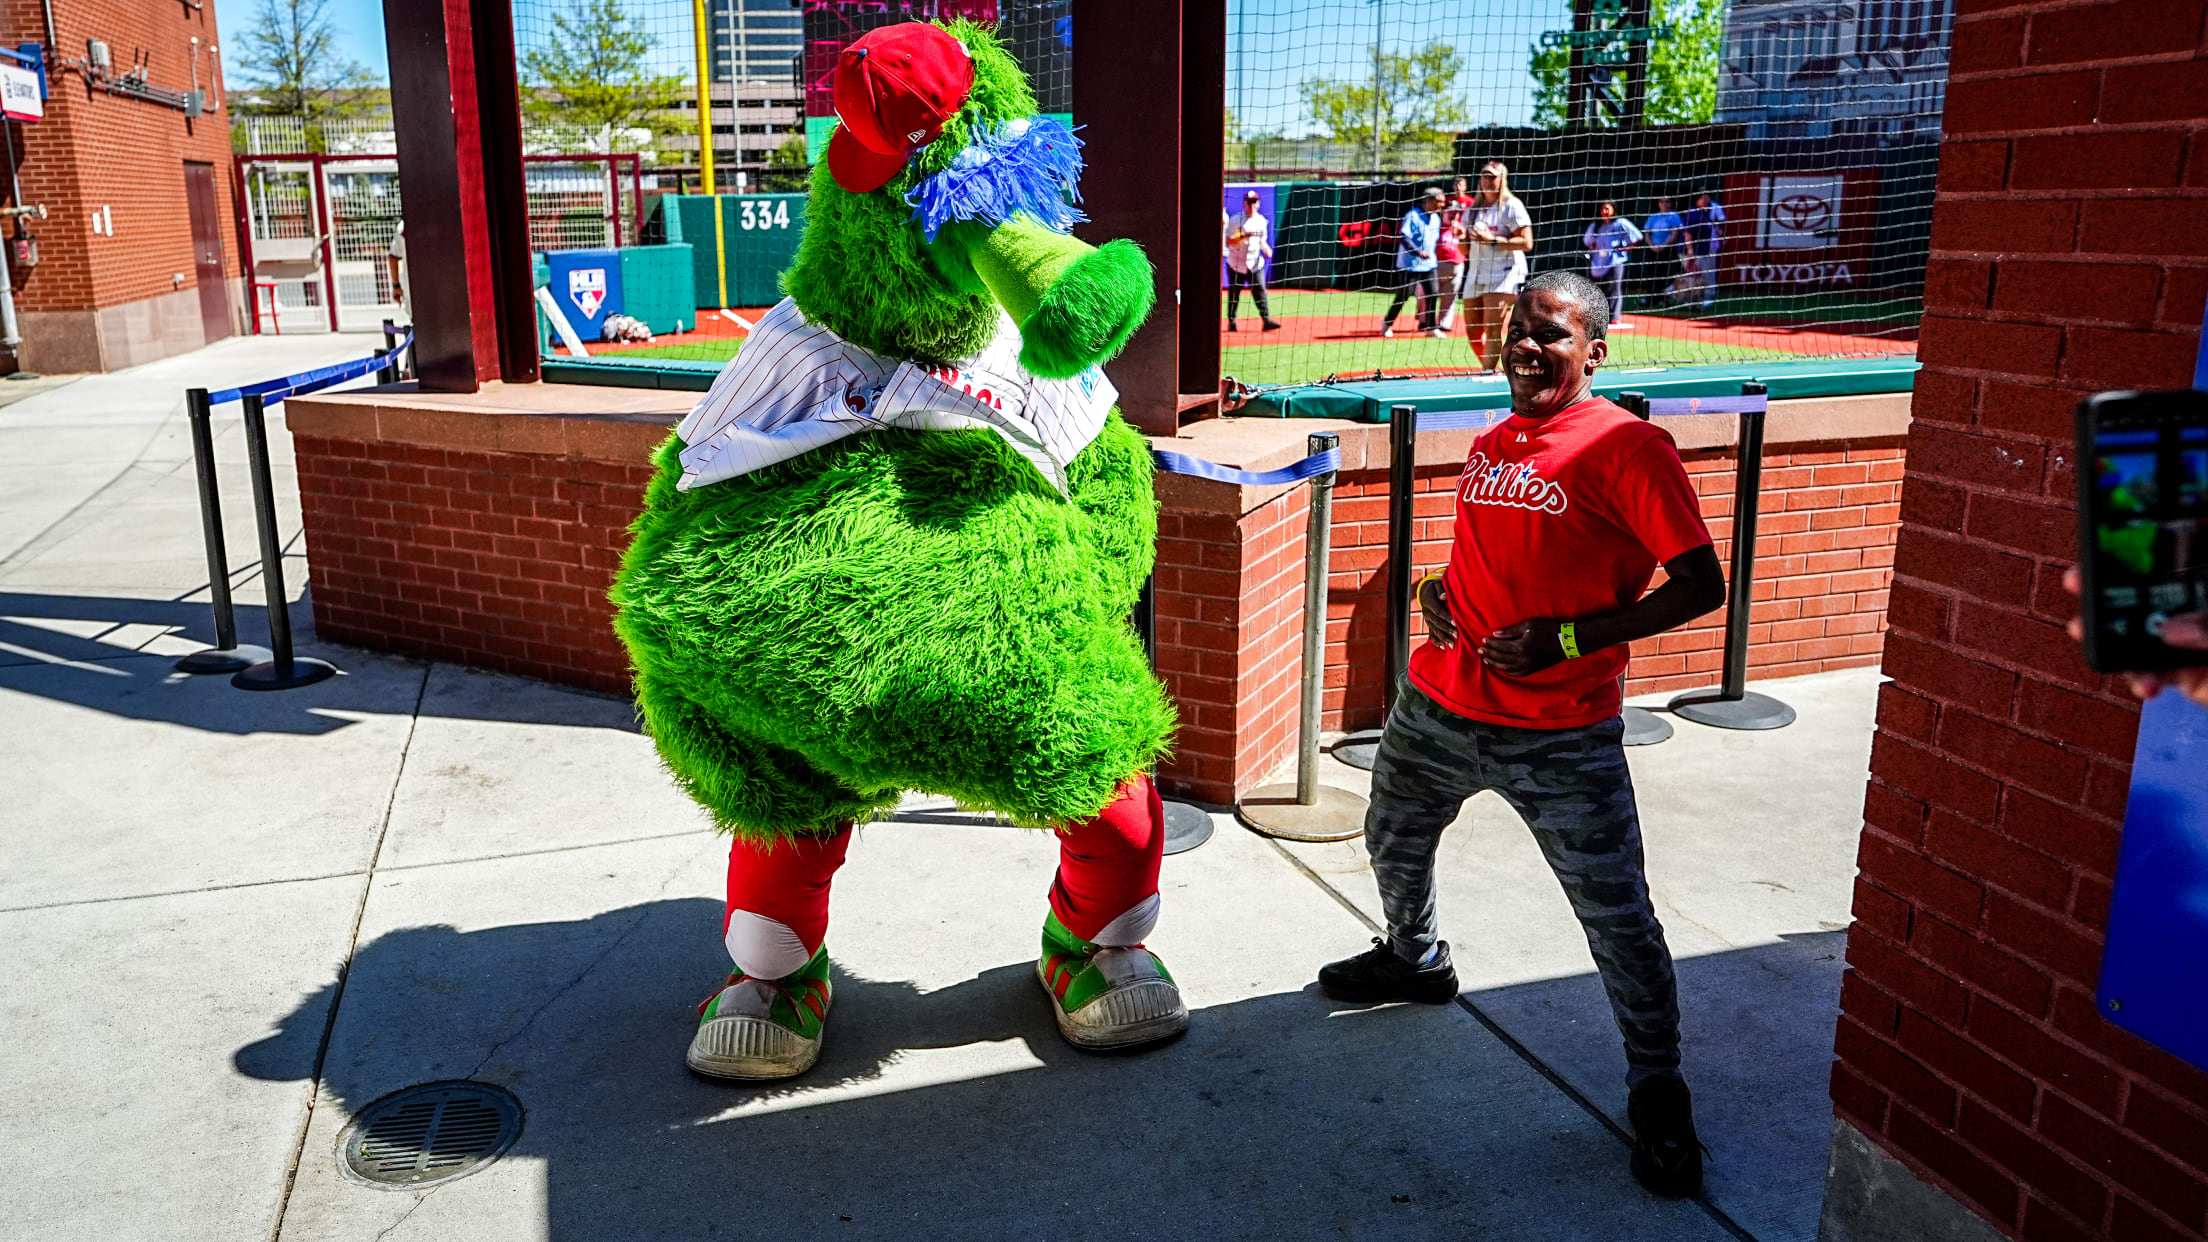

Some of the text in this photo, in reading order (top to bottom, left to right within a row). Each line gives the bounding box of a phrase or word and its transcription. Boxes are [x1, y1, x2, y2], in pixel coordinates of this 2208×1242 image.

[740, 200, 791, 231] 334
[1736, 263, 1854, 285] TOYOTA
[1457, 451, 1568, 515] Phillies
